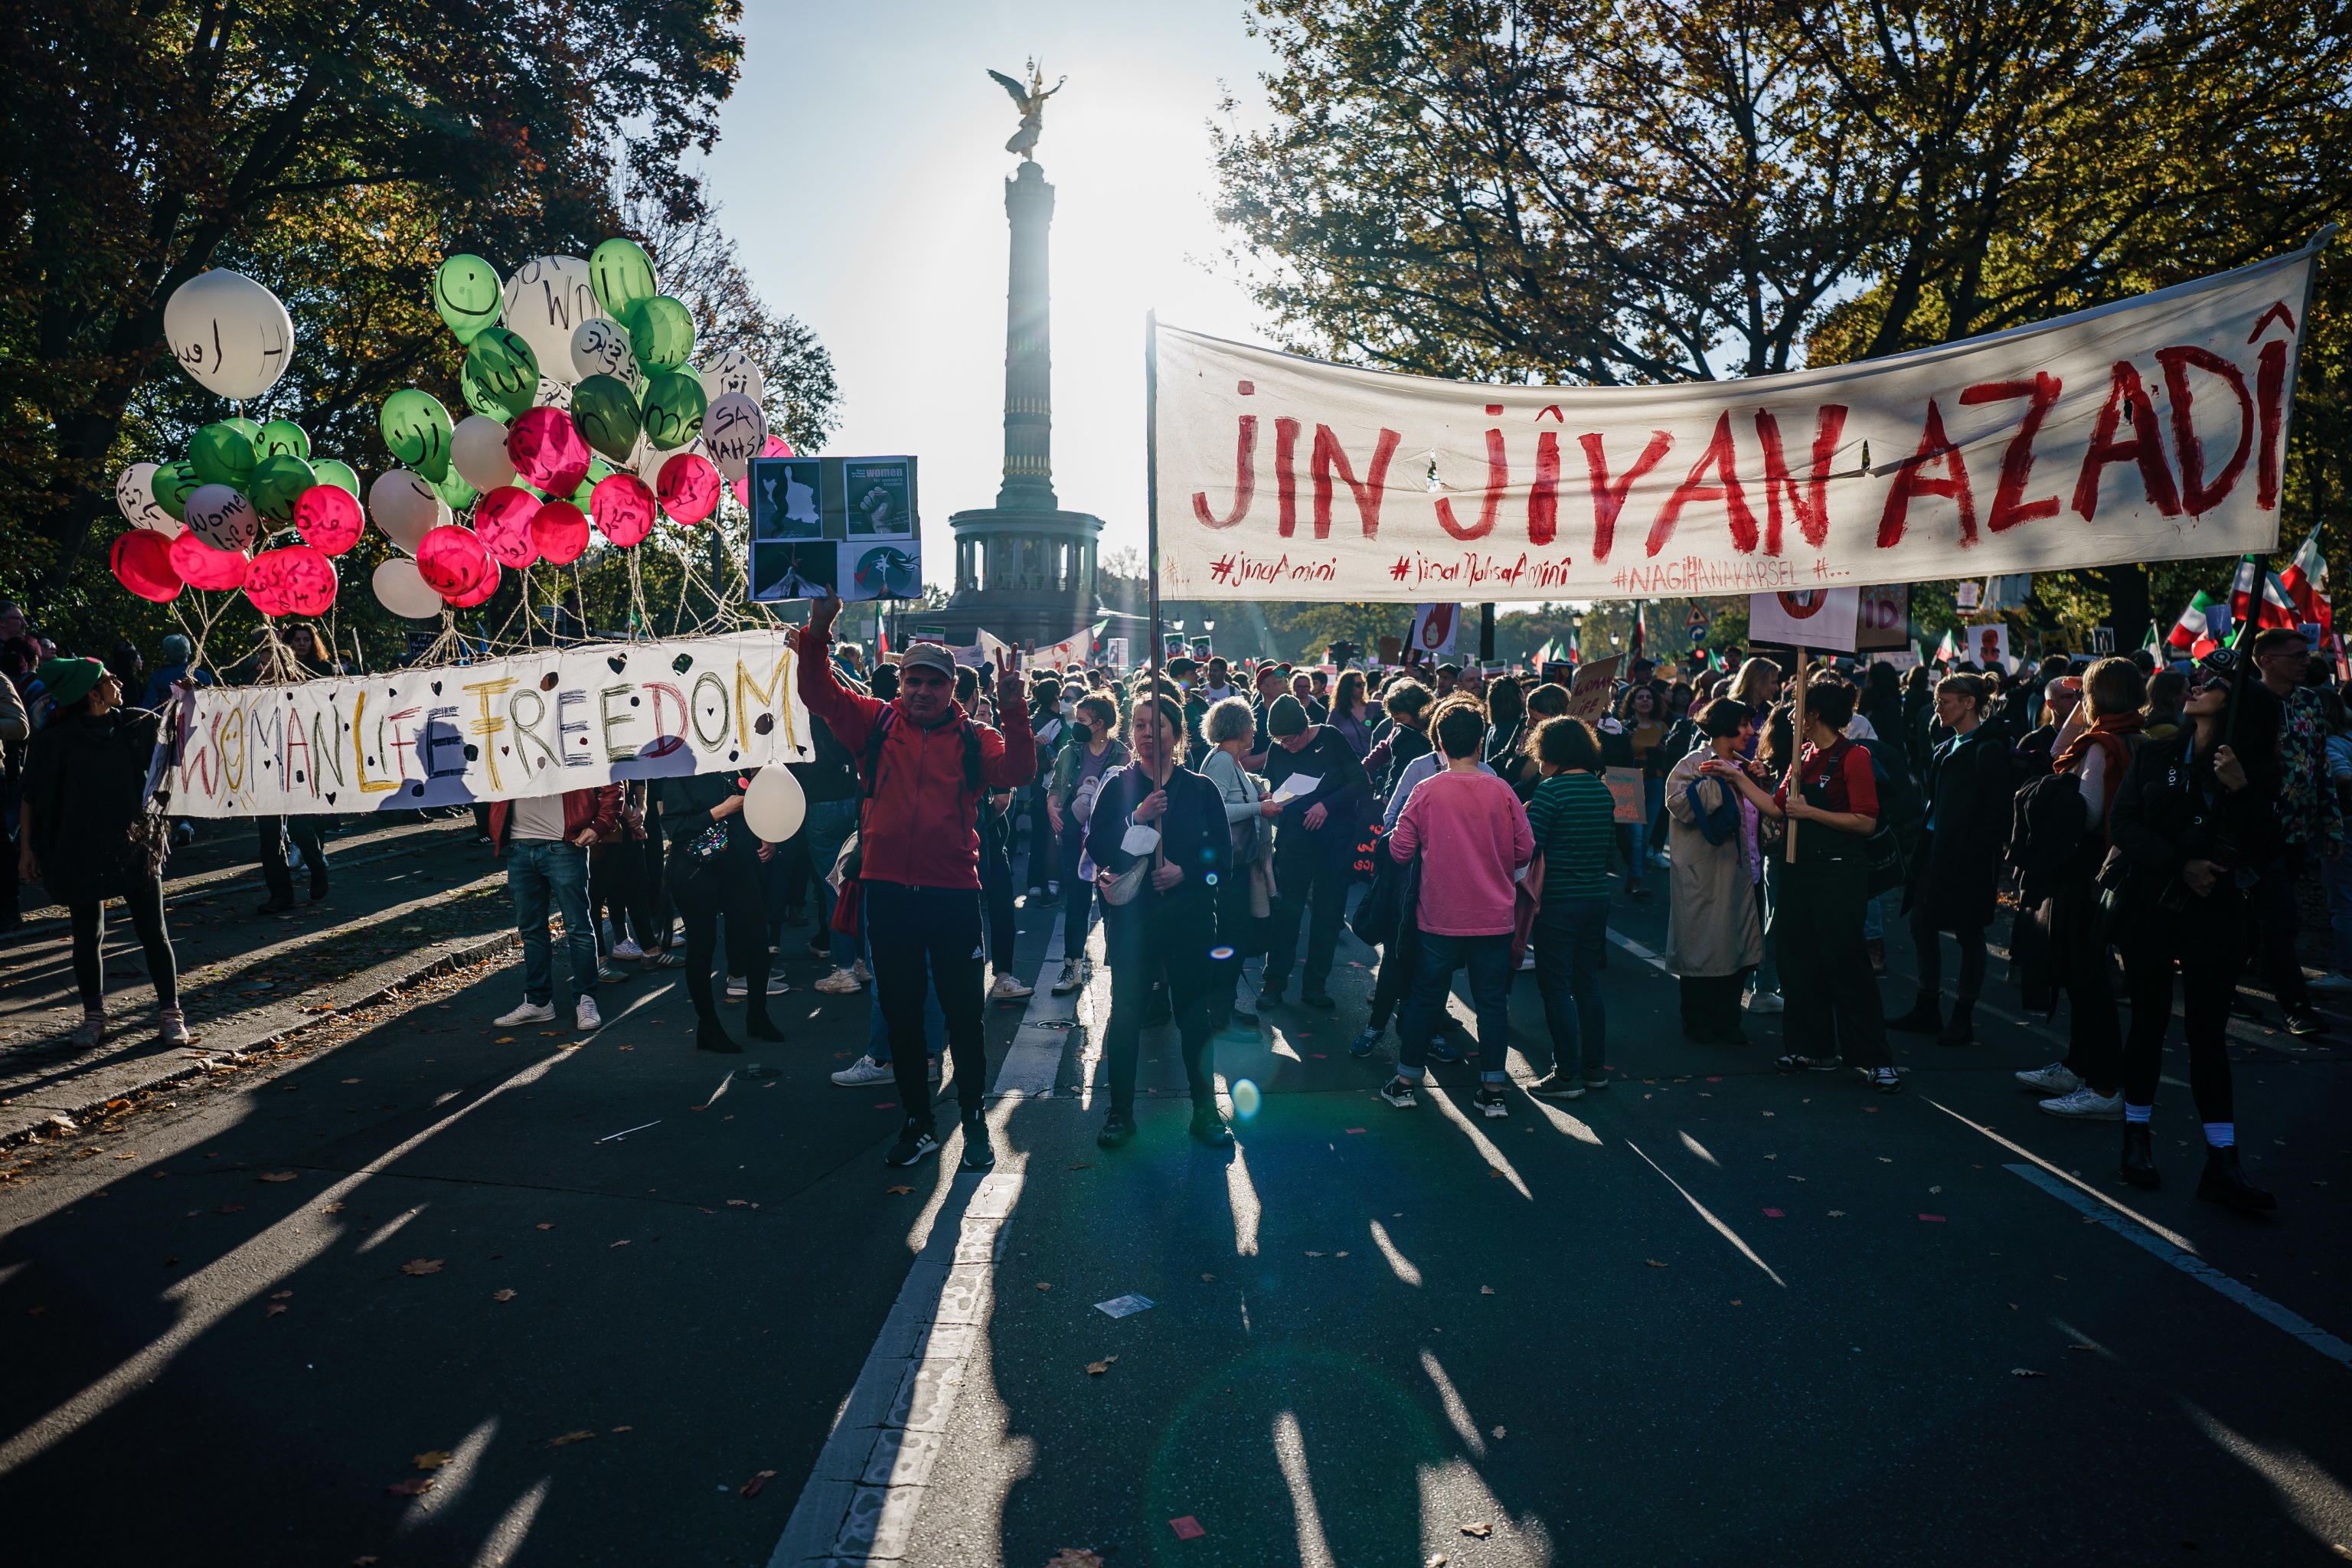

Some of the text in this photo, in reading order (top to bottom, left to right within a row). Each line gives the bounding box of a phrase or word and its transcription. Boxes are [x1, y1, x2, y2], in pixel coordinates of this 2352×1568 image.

[714, 404, 762, 436] SAY
[1192, 381, 1401, 541] JIN
[1876, 302, 2295, 549] AZADÎ
[705, 434, 766, 463] MAHSA
[866, 468, 903, 478] women
[177, 648, 798, 799] WOMAN LIFE FREEDOM
